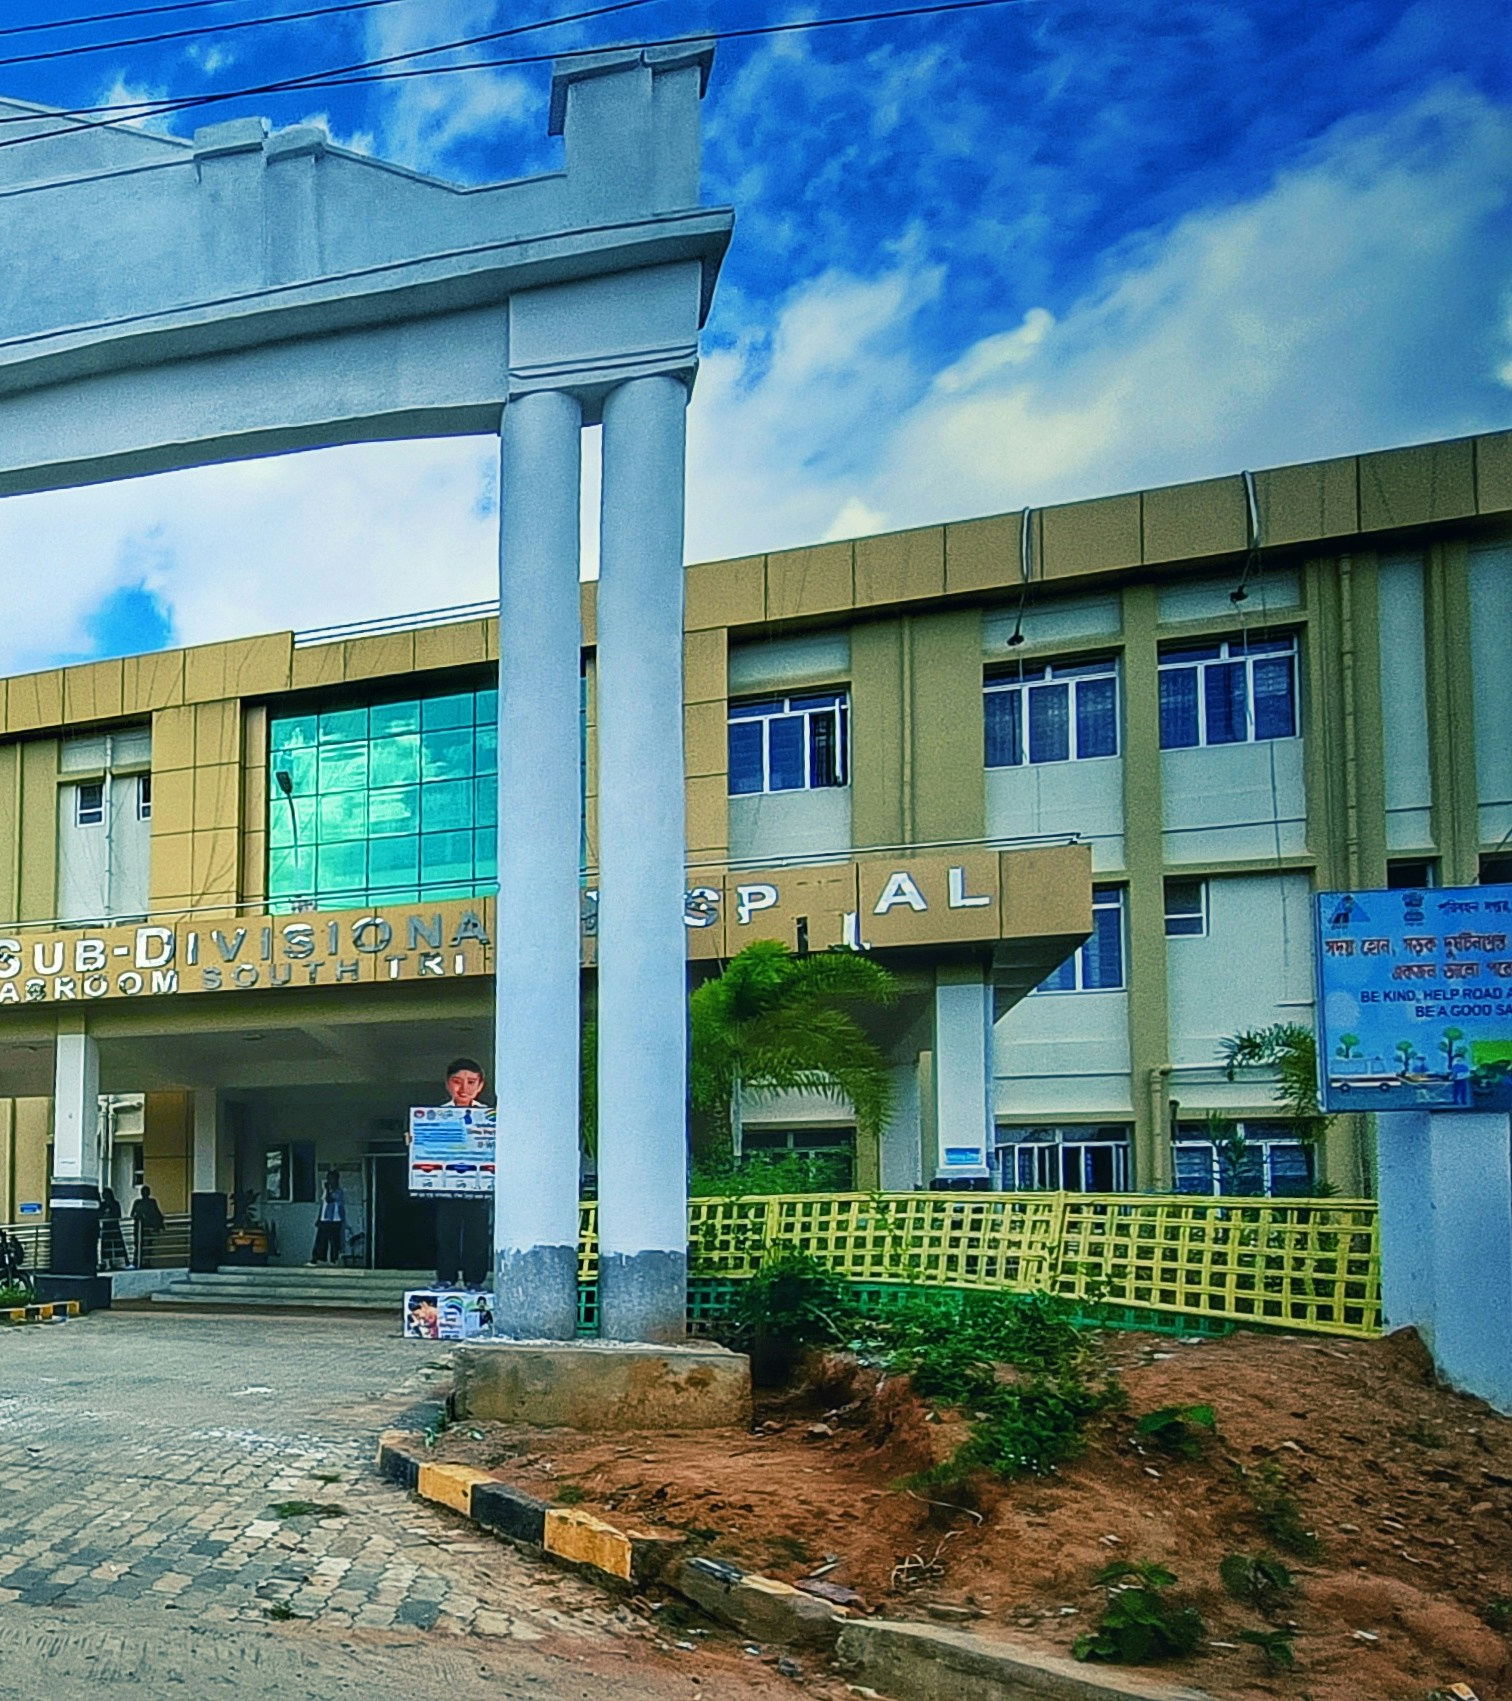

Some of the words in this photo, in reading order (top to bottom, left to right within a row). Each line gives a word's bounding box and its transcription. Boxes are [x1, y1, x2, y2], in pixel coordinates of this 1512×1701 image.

[201, 957, 360, 990] SOUTH
[1360, 990, 1380, 1002] BE
[1424, 988, 1459, 1001] HELP
[1462, 987, 1502, 1000] ROAD
[1415, 1005, 1435, 1017] BE
[1438, 1005, 1448, 1017] A
[1450, 1004, 1491, 1017] GOOD
